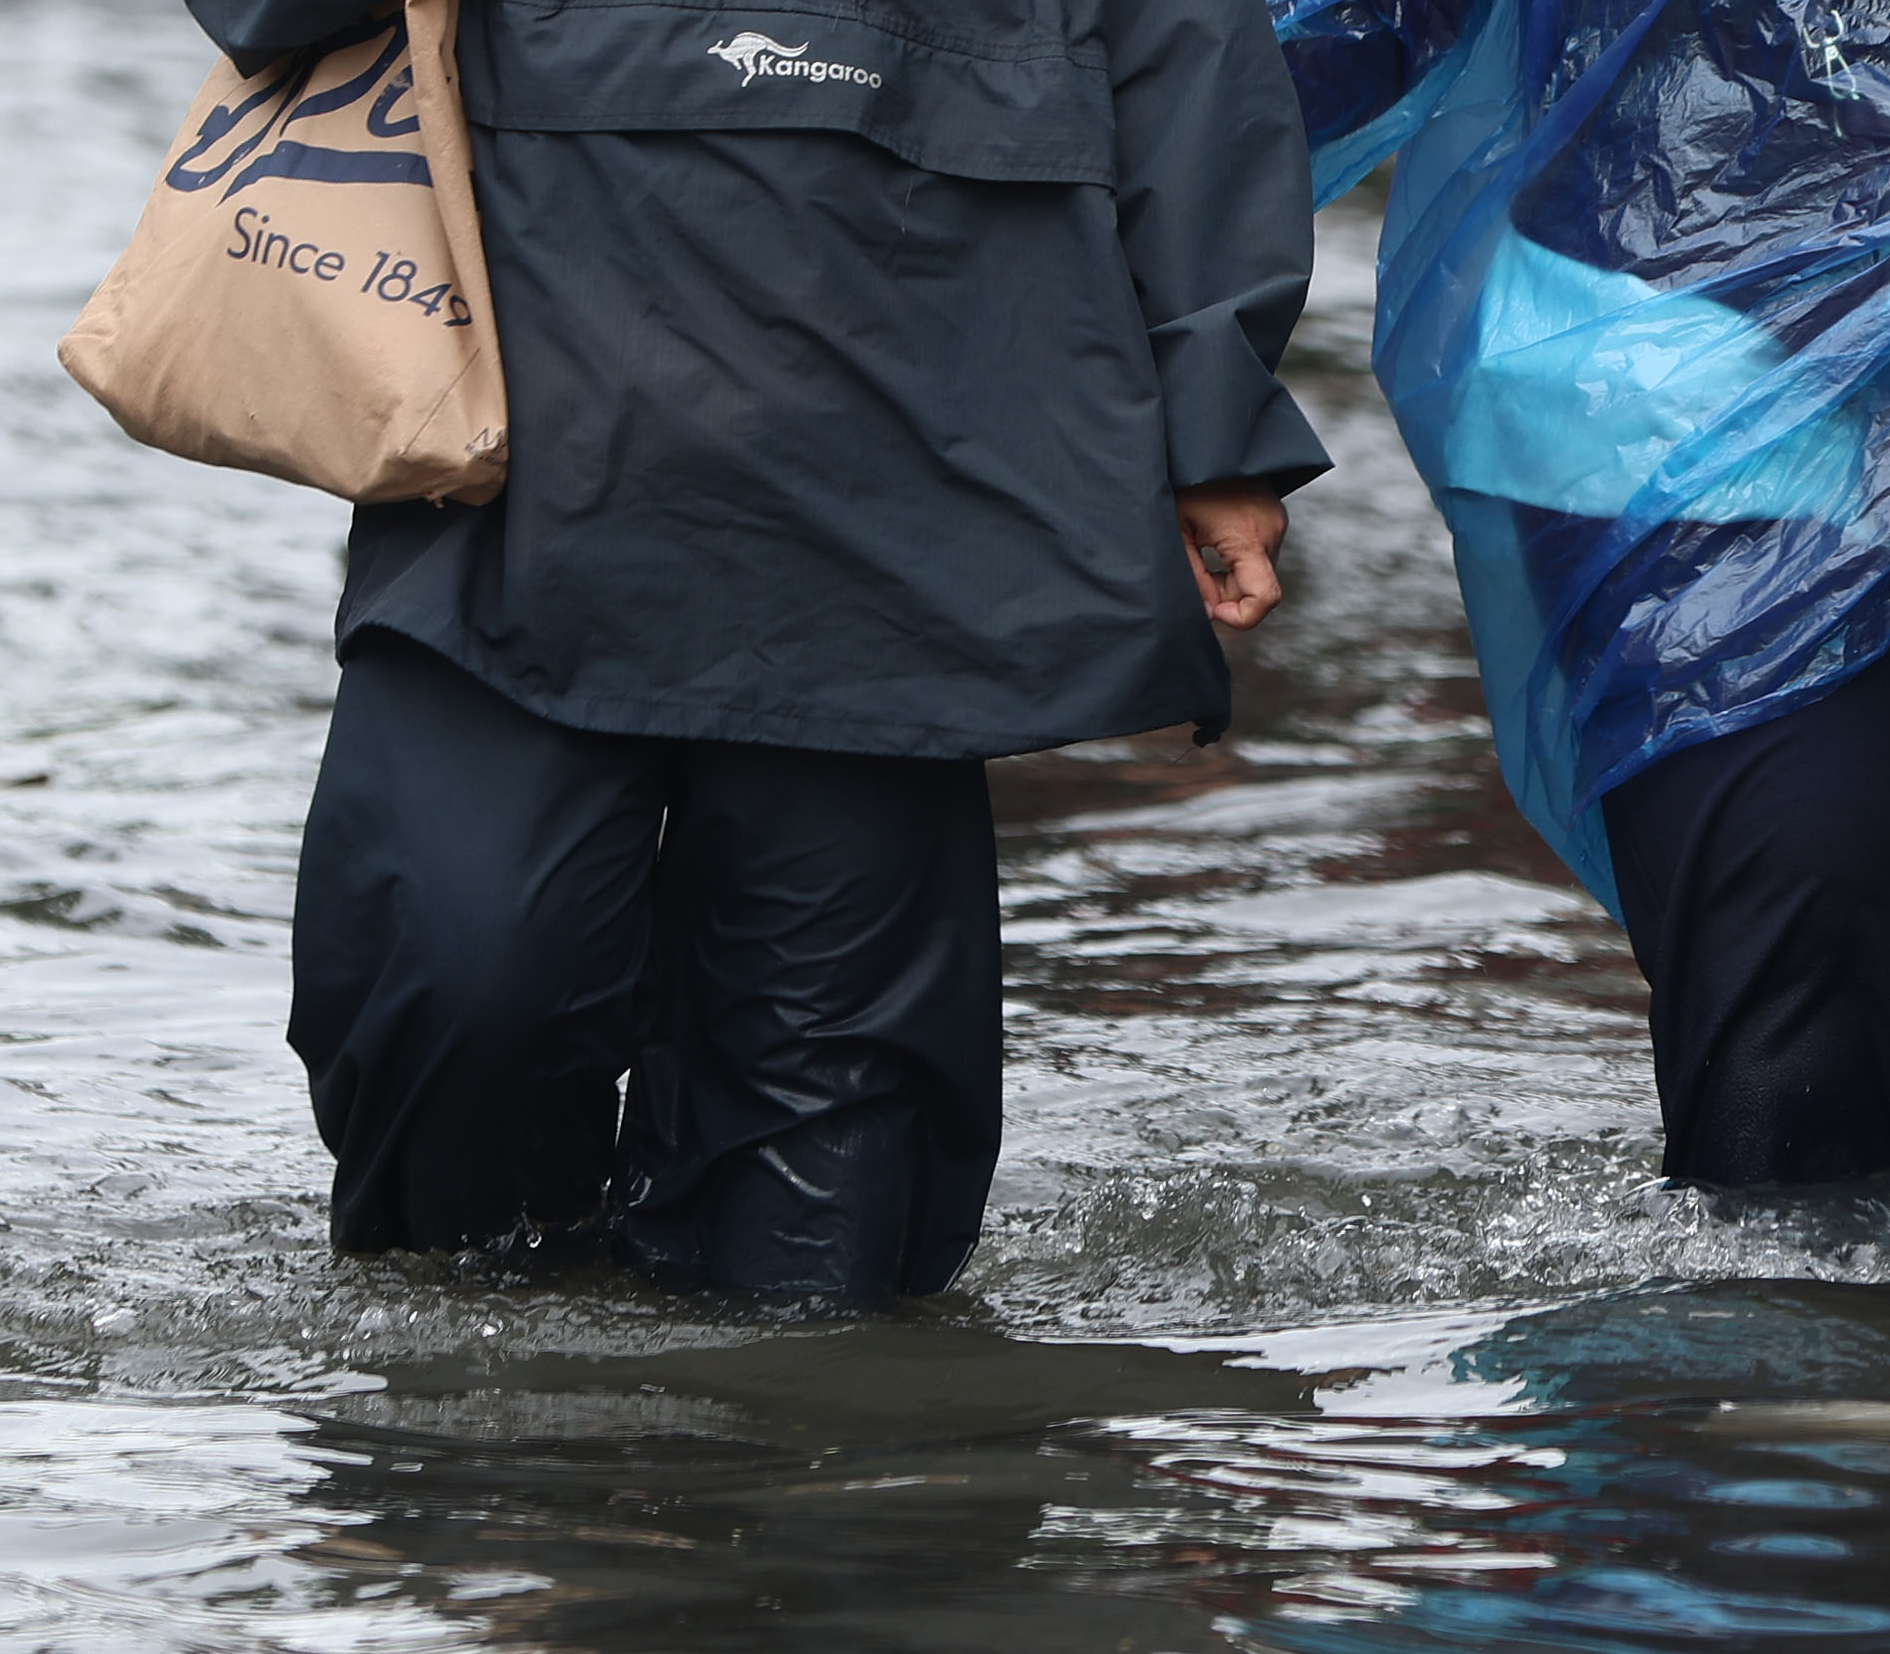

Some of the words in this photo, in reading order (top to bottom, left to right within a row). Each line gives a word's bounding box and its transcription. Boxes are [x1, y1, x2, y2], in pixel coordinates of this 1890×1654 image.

[758, 54, 882, 89] Kangaroo
[227, 207, 345, 281] Since
[360, 250, 473, 327] 1849
